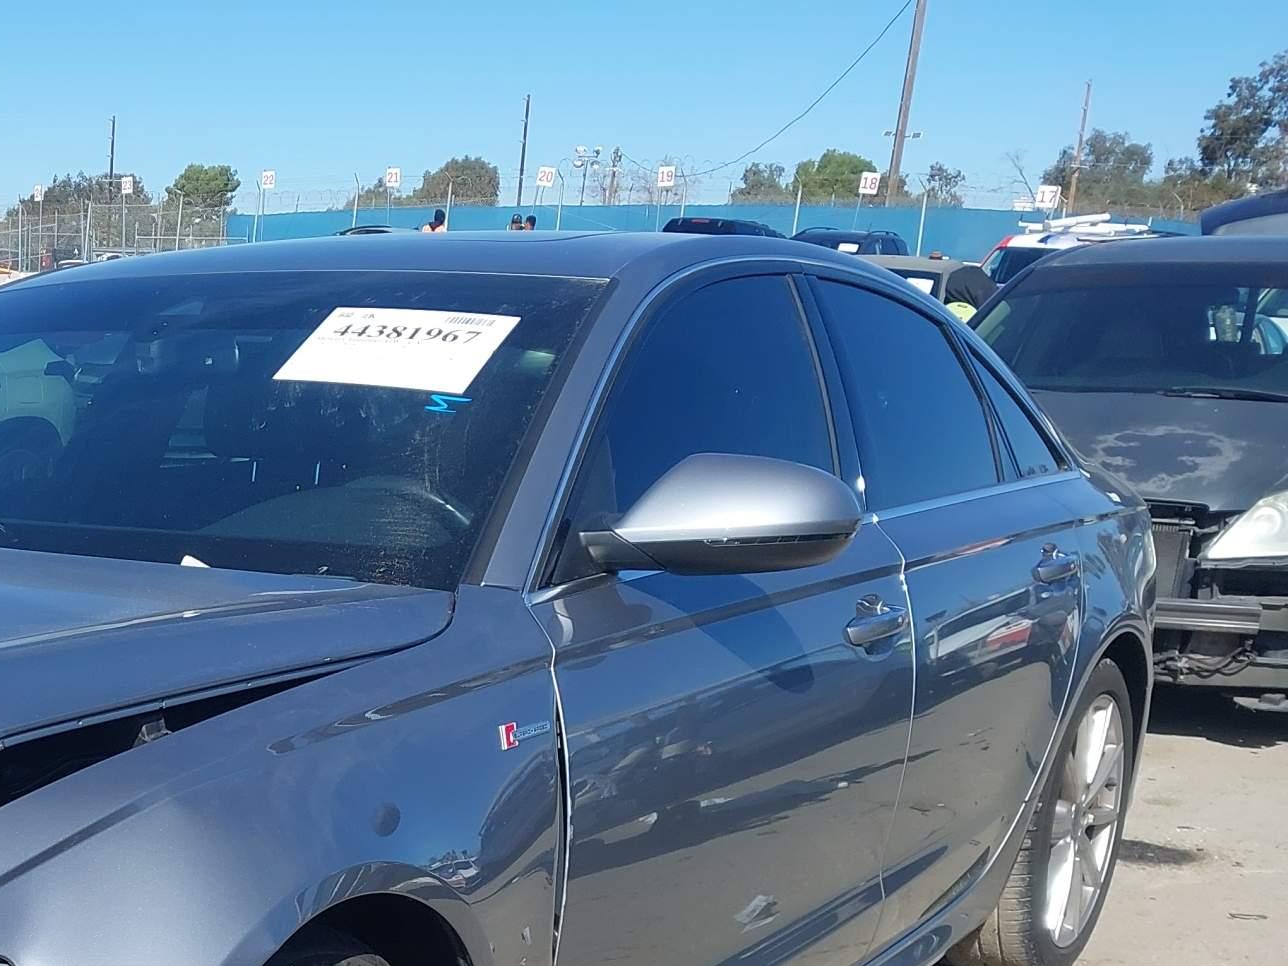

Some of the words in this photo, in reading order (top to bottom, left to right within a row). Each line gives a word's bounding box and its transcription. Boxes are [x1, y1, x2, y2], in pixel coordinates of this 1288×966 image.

[263, 174, 274, 185] 22
[387, 171, 399, 184] 21
[538, 170, 554, 183] 20
[659, 170, 674, 183] 19
[861, 176, 878, 190] 18
[122, 180, 132, 191] 23
[1038, 189, 1057, 204] 17
[332, 324, 483, 345] 44381967
